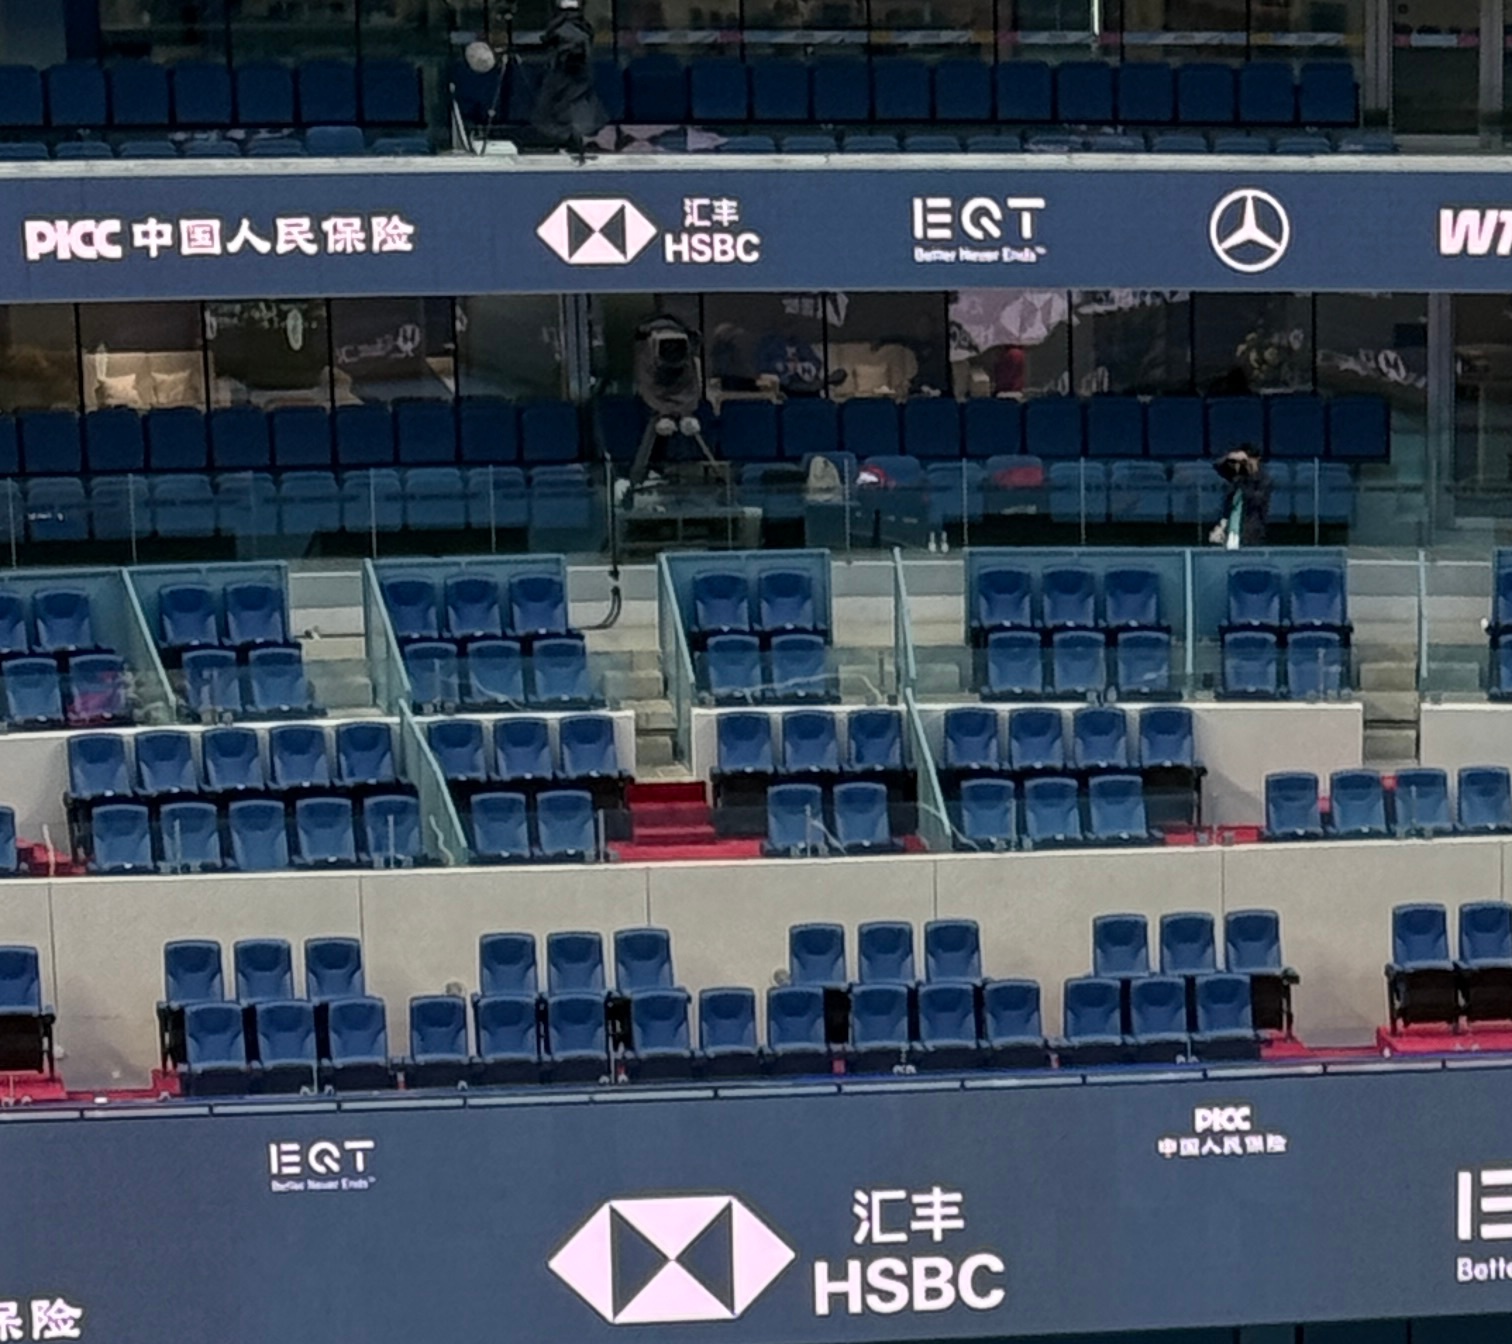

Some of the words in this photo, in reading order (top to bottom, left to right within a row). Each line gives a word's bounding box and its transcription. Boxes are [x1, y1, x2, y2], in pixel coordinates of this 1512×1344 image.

[683, 198, 740, 227] 汇丰
[912, 196, 1046, 240] EQT
[25, 219, 121, 260] PICC
[132, 215, 415, 258] 中国人民保险
[665, 233, 760, 264] HSBC
[1194, 1105, 1252, 1133] PICC
[268, 1139, 376, 1175] EQT
[851, 1186, 965, 1245] 汇丰
[814, 1252, 1006, 1316] HSBC
